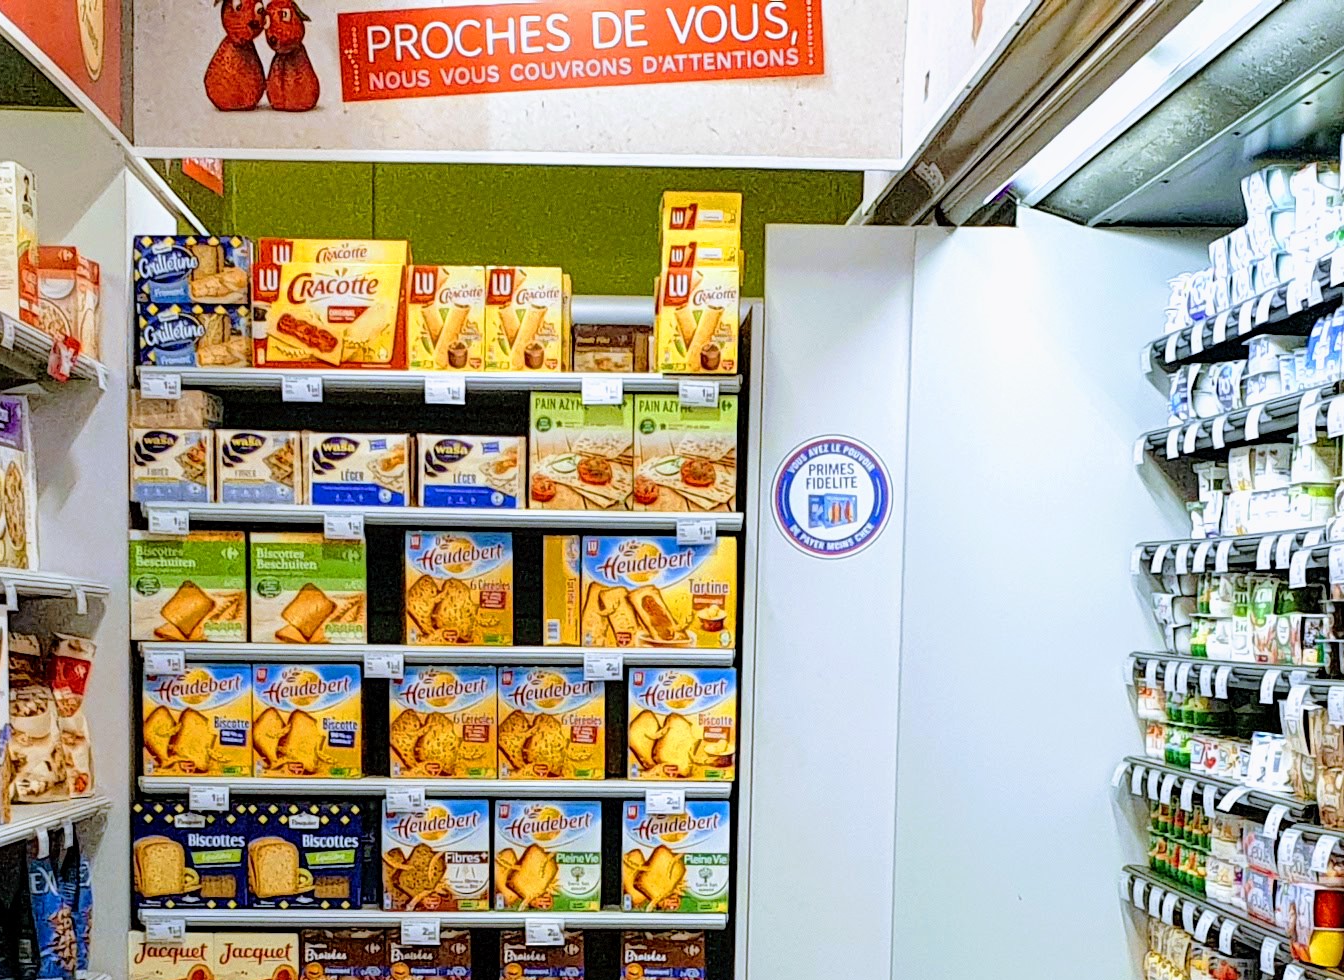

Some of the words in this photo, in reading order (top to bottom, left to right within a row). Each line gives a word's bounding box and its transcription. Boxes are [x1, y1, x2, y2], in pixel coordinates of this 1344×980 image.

[366, 12, 570, 62] PROCHES
[592, 12, 648, 50] DE
[672, 2, 798, 47] VOUS,
[369, 71, 430, 90] NOUS
[441, 65, 499, 85] VOUS
[510, 58, 632, 81] COUVRONS
[642, 48, 799, 75] D'ATTENTIONS
[259, 268, 279, 292] LU
[415, 273, 434, 295] LU
[492, 273, 512, 295] LU
[668, 275, 689, 297] LU
[535, 397, 555, 410] PAIN
[808, 463, 855, 476] PRIMES
[416, 543, 504, 571] Heudebert
[598, 550, 694, 578] Heudebert
[688, 579, 729, 594] Tartine
[153, 675, 242, 702] Heudebert
[262, 676, 351, 702] Heudebert
[400, 677, 488, 704] Heudebert
[509, 679, 596, 705] Heudebert
[639, 678, 727, 706] Heudebert
[213, 715, 250, 729] Biscotte
[322, 716, 358, 730] Biscotte
[391, 810, 480, 840] Heudebert
[506, 811, 593, 839] Heudebert
[634, 811, 720, 841] Heudebert
[187, 833, 245, 848] Biscottes
[302, 833, 359, 849] Biscottes
[134, 941, 208, 965] Jacquet
[219, 942, 294, 965] Jacquet
